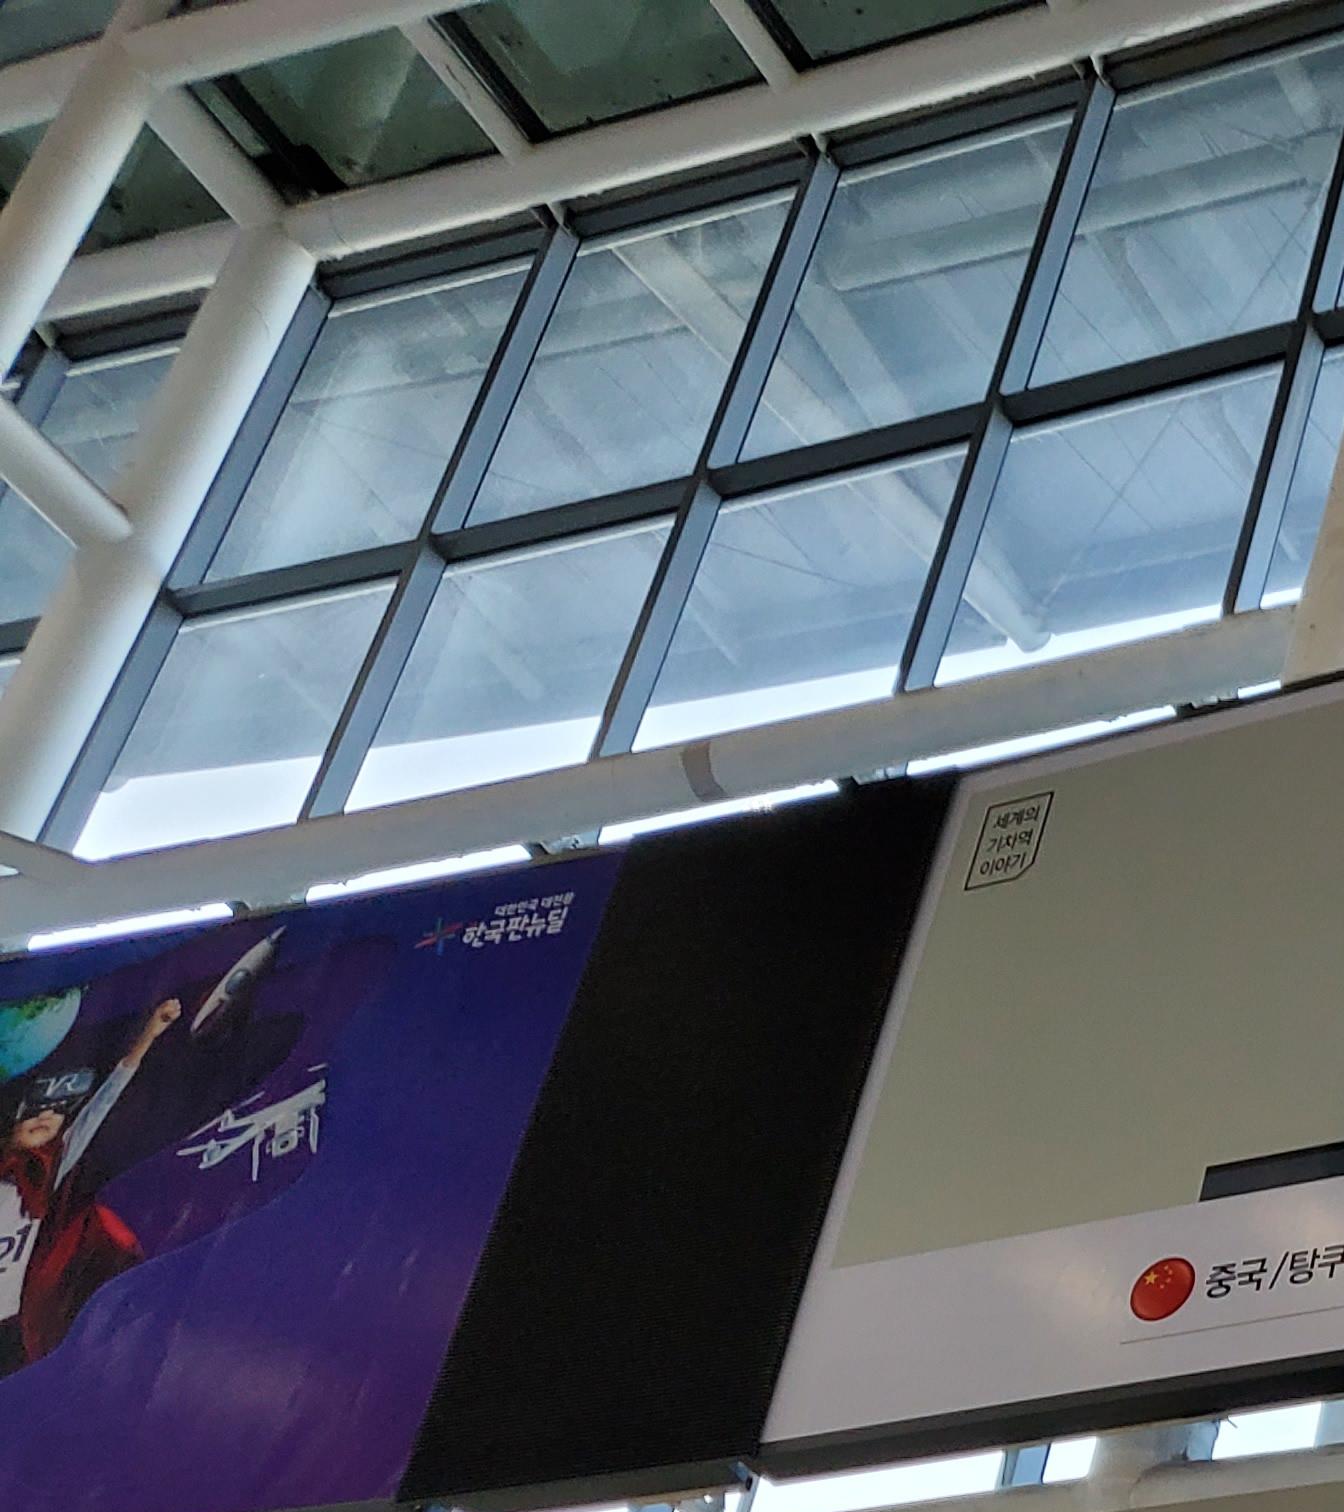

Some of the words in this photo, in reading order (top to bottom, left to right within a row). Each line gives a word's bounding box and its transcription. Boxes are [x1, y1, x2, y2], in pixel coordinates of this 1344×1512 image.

[993, 804, 1041, 829] 세계의
[986, 828, 1034, 853] 기차역
[979, 852, 1027, 876] 이야기
